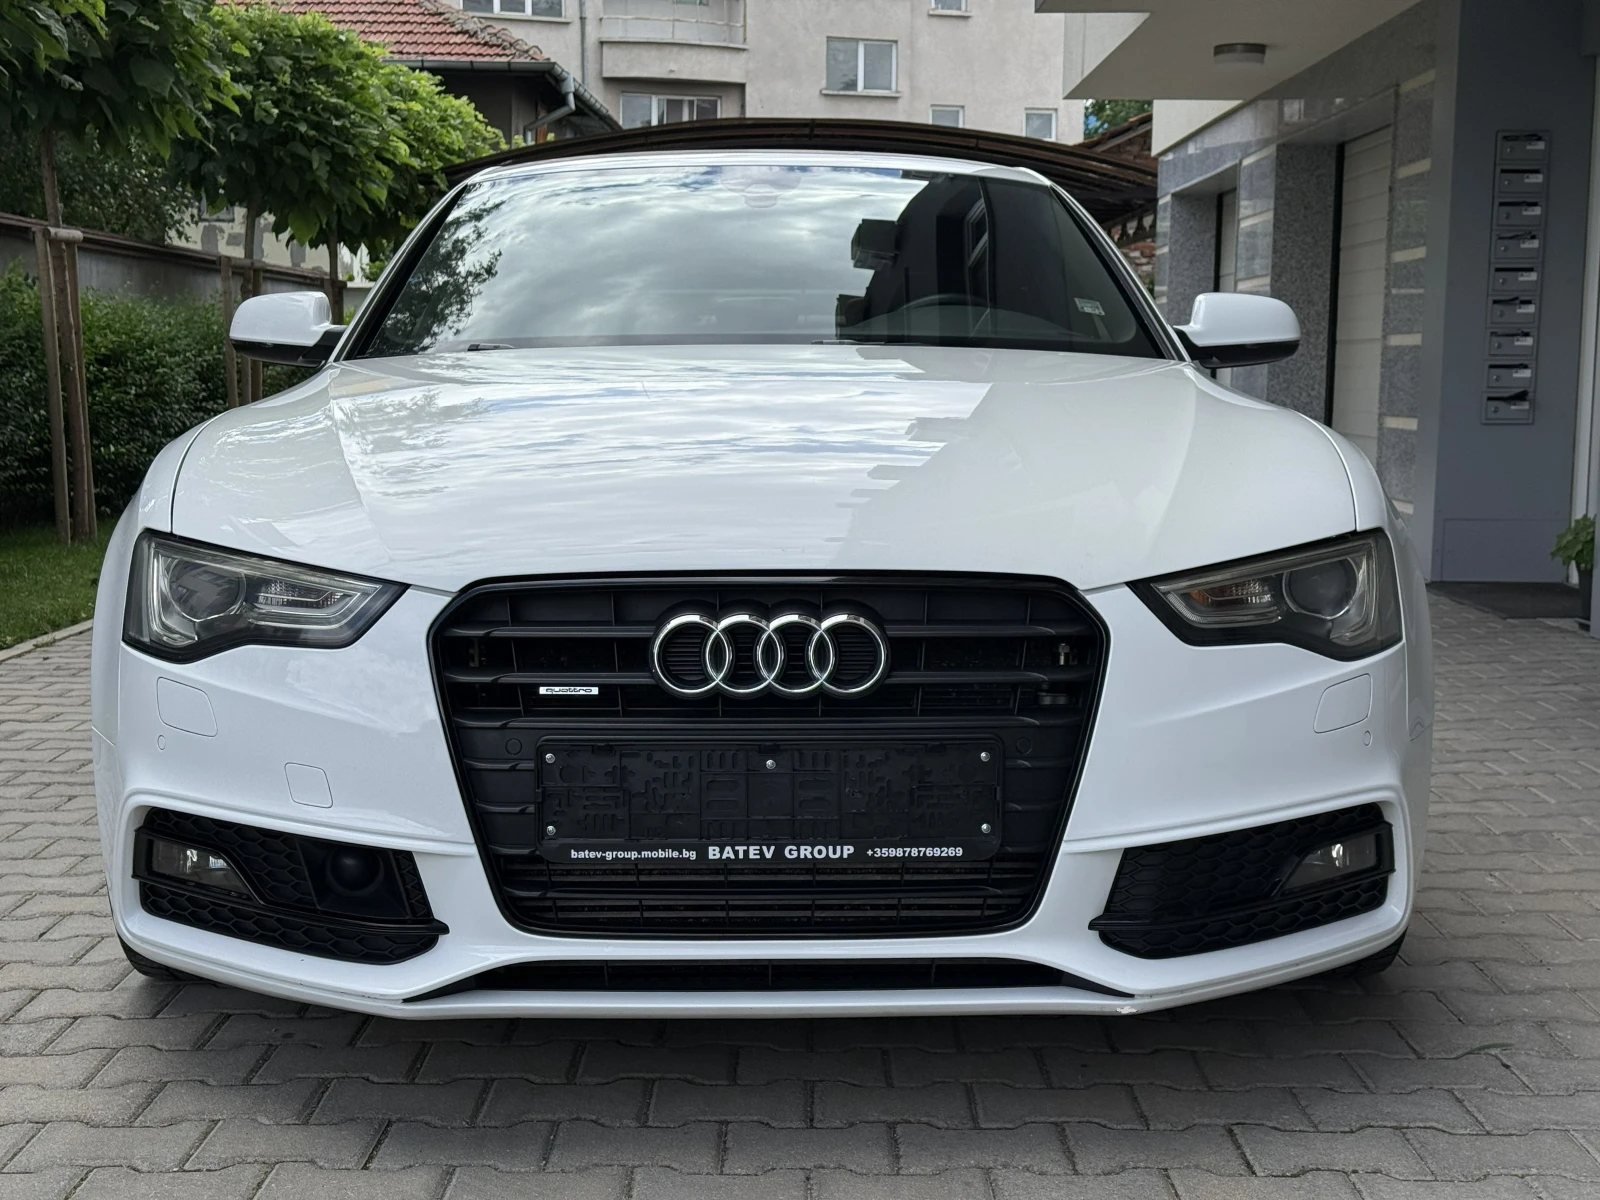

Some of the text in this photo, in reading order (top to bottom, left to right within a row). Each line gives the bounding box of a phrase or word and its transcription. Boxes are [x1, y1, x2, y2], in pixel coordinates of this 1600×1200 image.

[545, 687, 593, 695] quattro
[570, 845, 964, 861] batev-group.mobile.bg BATEV GROUP +359878769269
